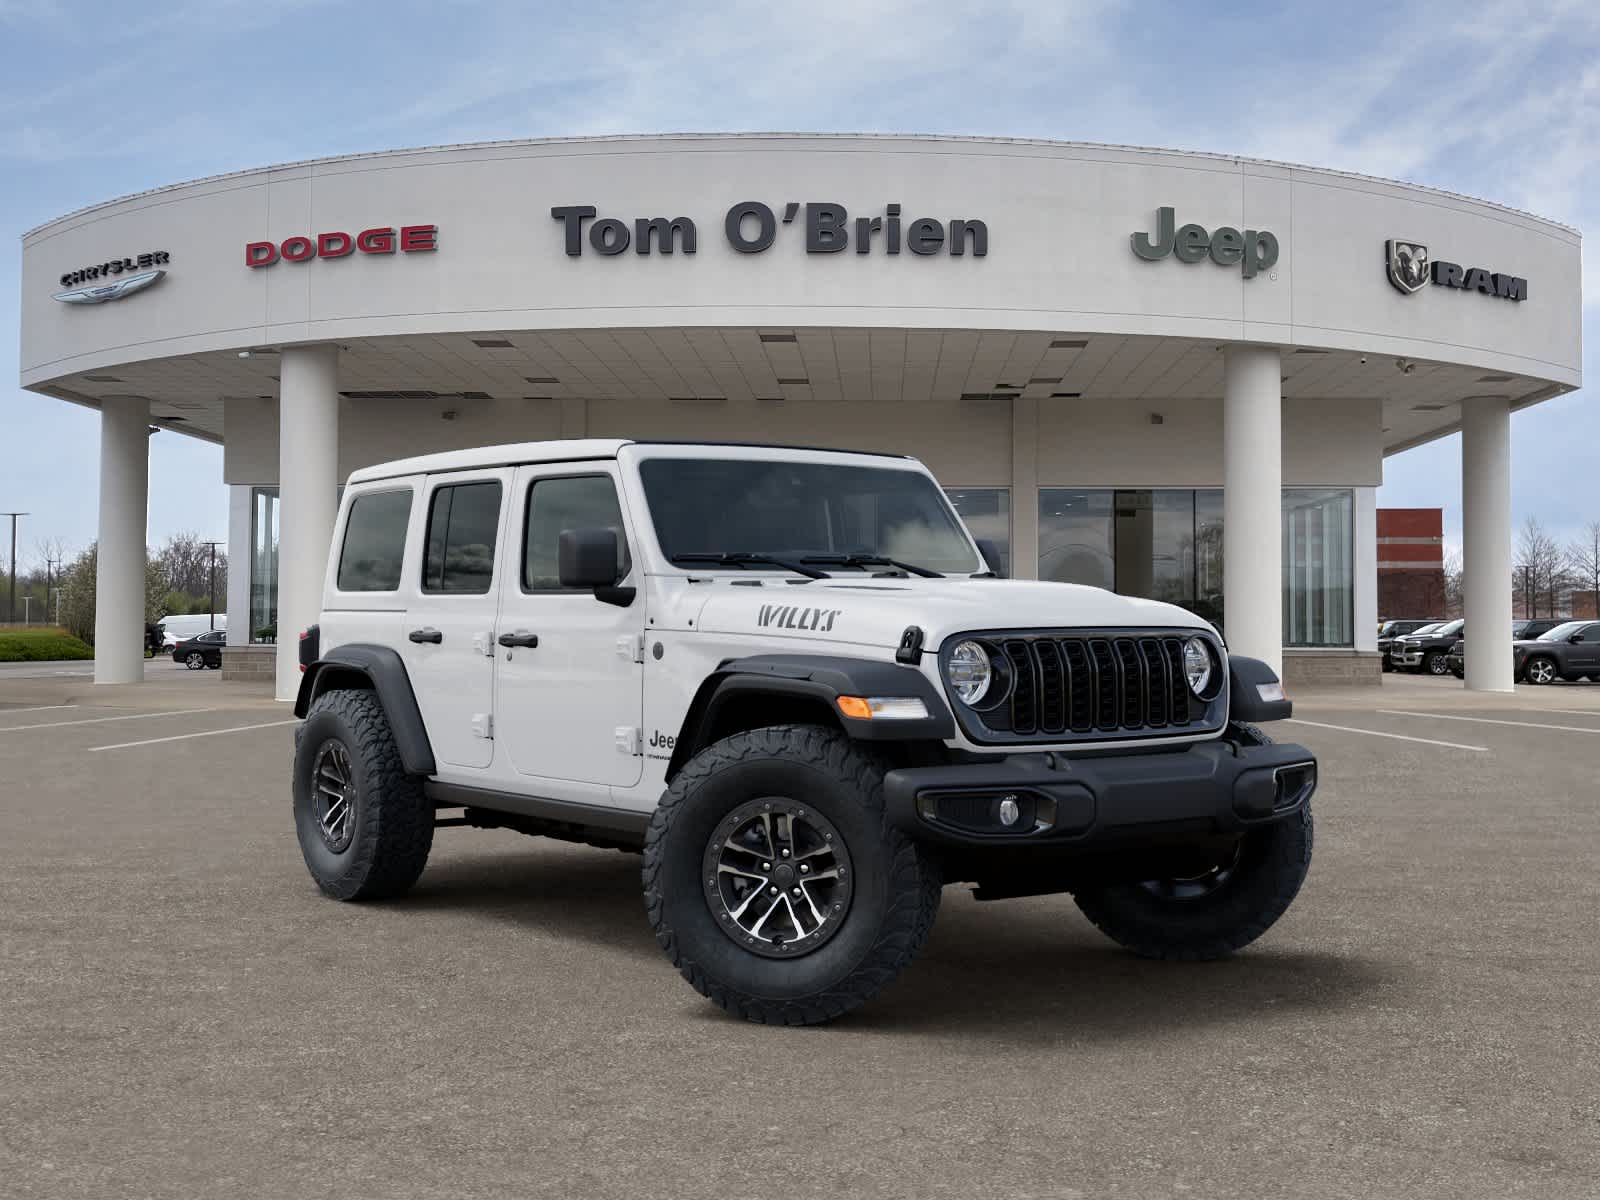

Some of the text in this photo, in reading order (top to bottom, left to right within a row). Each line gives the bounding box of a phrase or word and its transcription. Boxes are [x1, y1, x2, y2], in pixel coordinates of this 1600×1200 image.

[245, 224, 438, 269] DODGE
[551, 201, 988, 257] Tom O'Brien
[1130, 206, 1279, 279] Jeep
[60, 250, 170, 287] CHRYSLER
[1431, 260, 1528, 302] RAM
[758, 604, 842, 632] WILLYS
[649, 729, 678, 749] Jee
